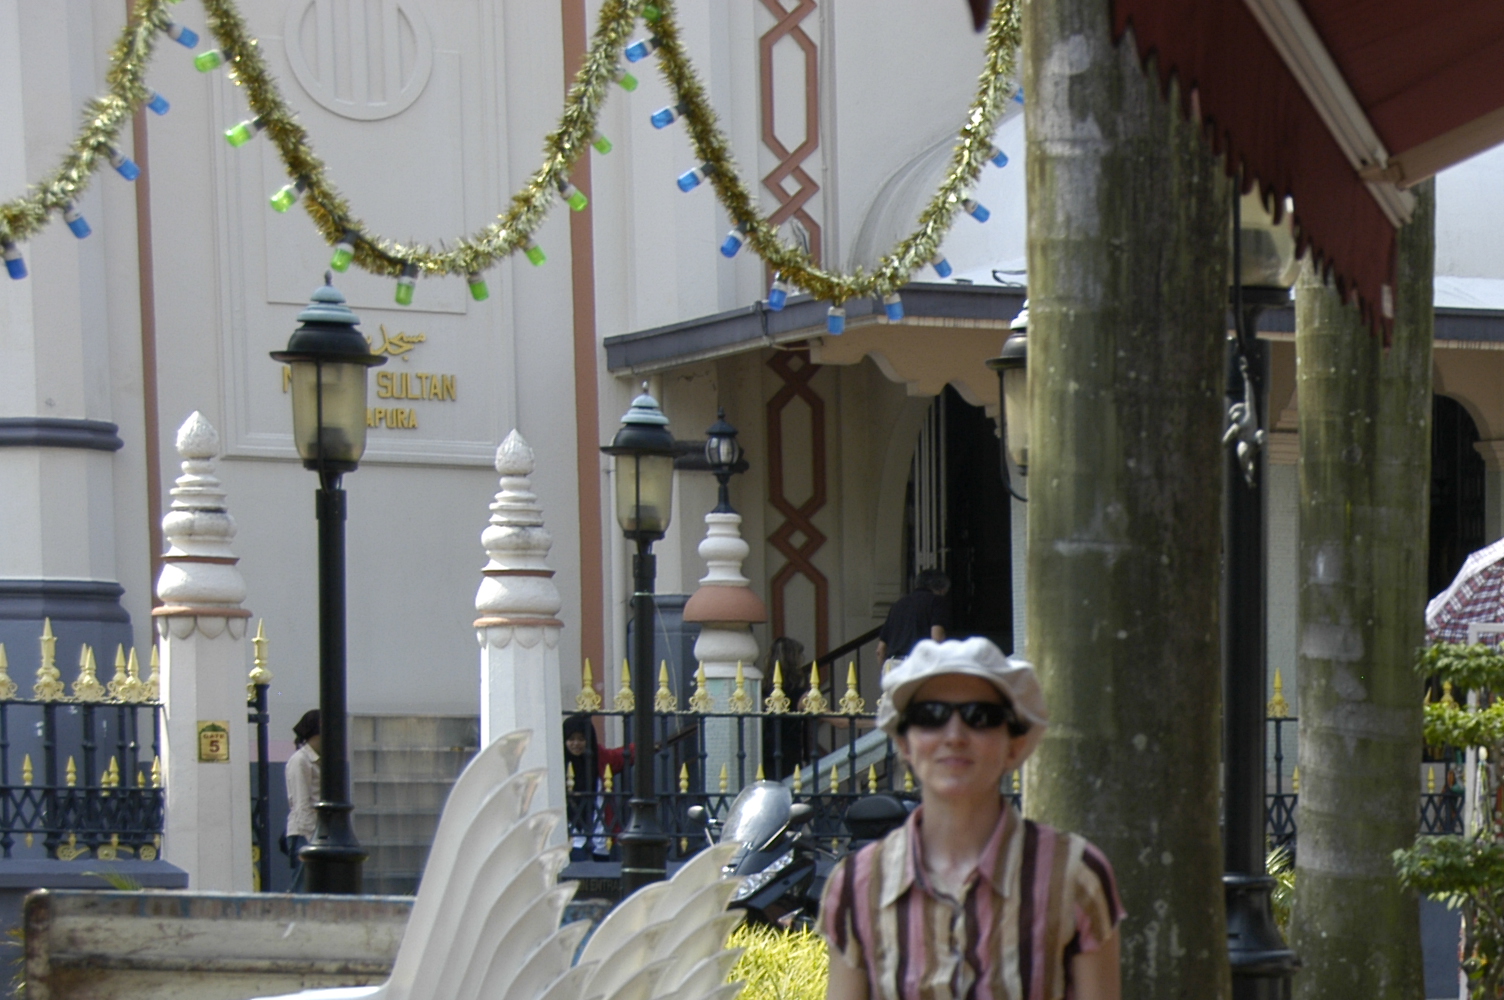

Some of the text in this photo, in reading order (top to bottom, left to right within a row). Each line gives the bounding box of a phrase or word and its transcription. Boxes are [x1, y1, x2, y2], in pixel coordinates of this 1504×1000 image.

[377, 371, 457, 401] SULTAN
[366, 407, 419, 429] APURA
[209, 740, 220, 753] 5
